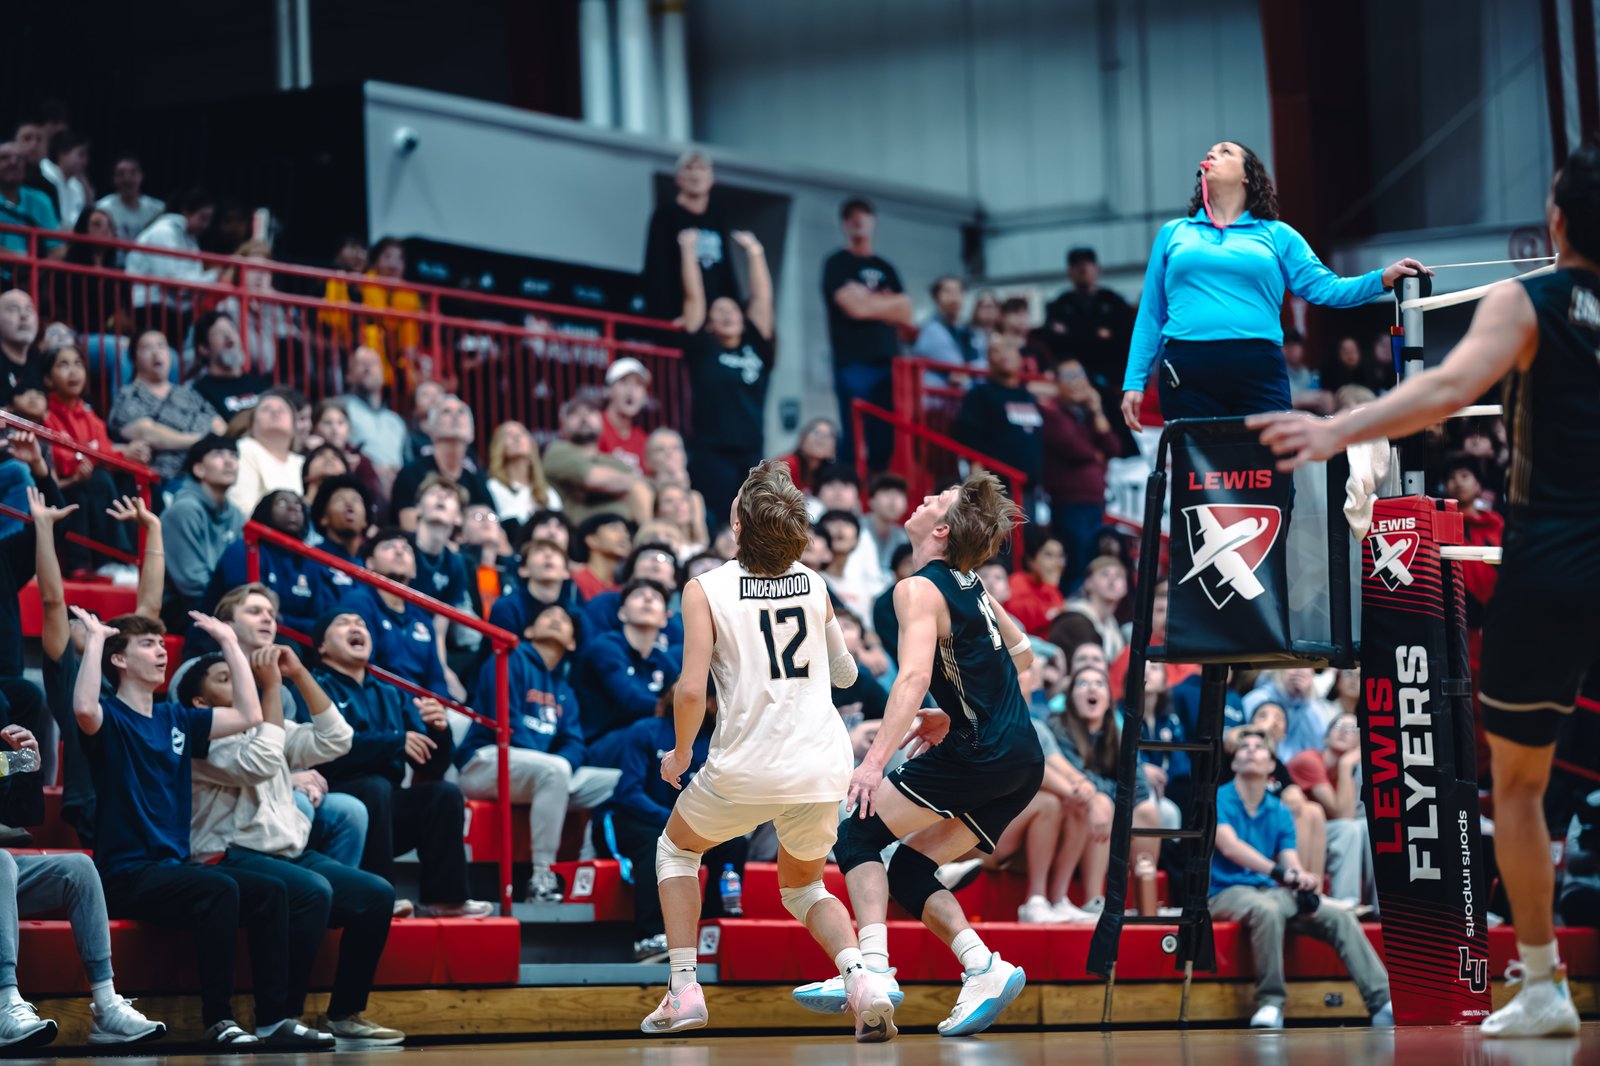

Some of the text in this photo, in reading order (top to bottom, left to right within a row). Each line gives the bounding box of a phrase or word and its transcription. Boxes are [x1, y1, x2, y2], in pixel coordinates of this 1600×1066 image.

[1188, 469, 1272, 490] LEWIS
[1370, 517, 1416, 533] LEWIS
[741, 575, 809, 598] LINDENWOOD
[759, 606, 809, 680] 12
[1366, 677, 1403, 854] LEWIS
[1395, 645, 1442, 882] FLYERS
[1458, 810, 1475, 937] sports imports
